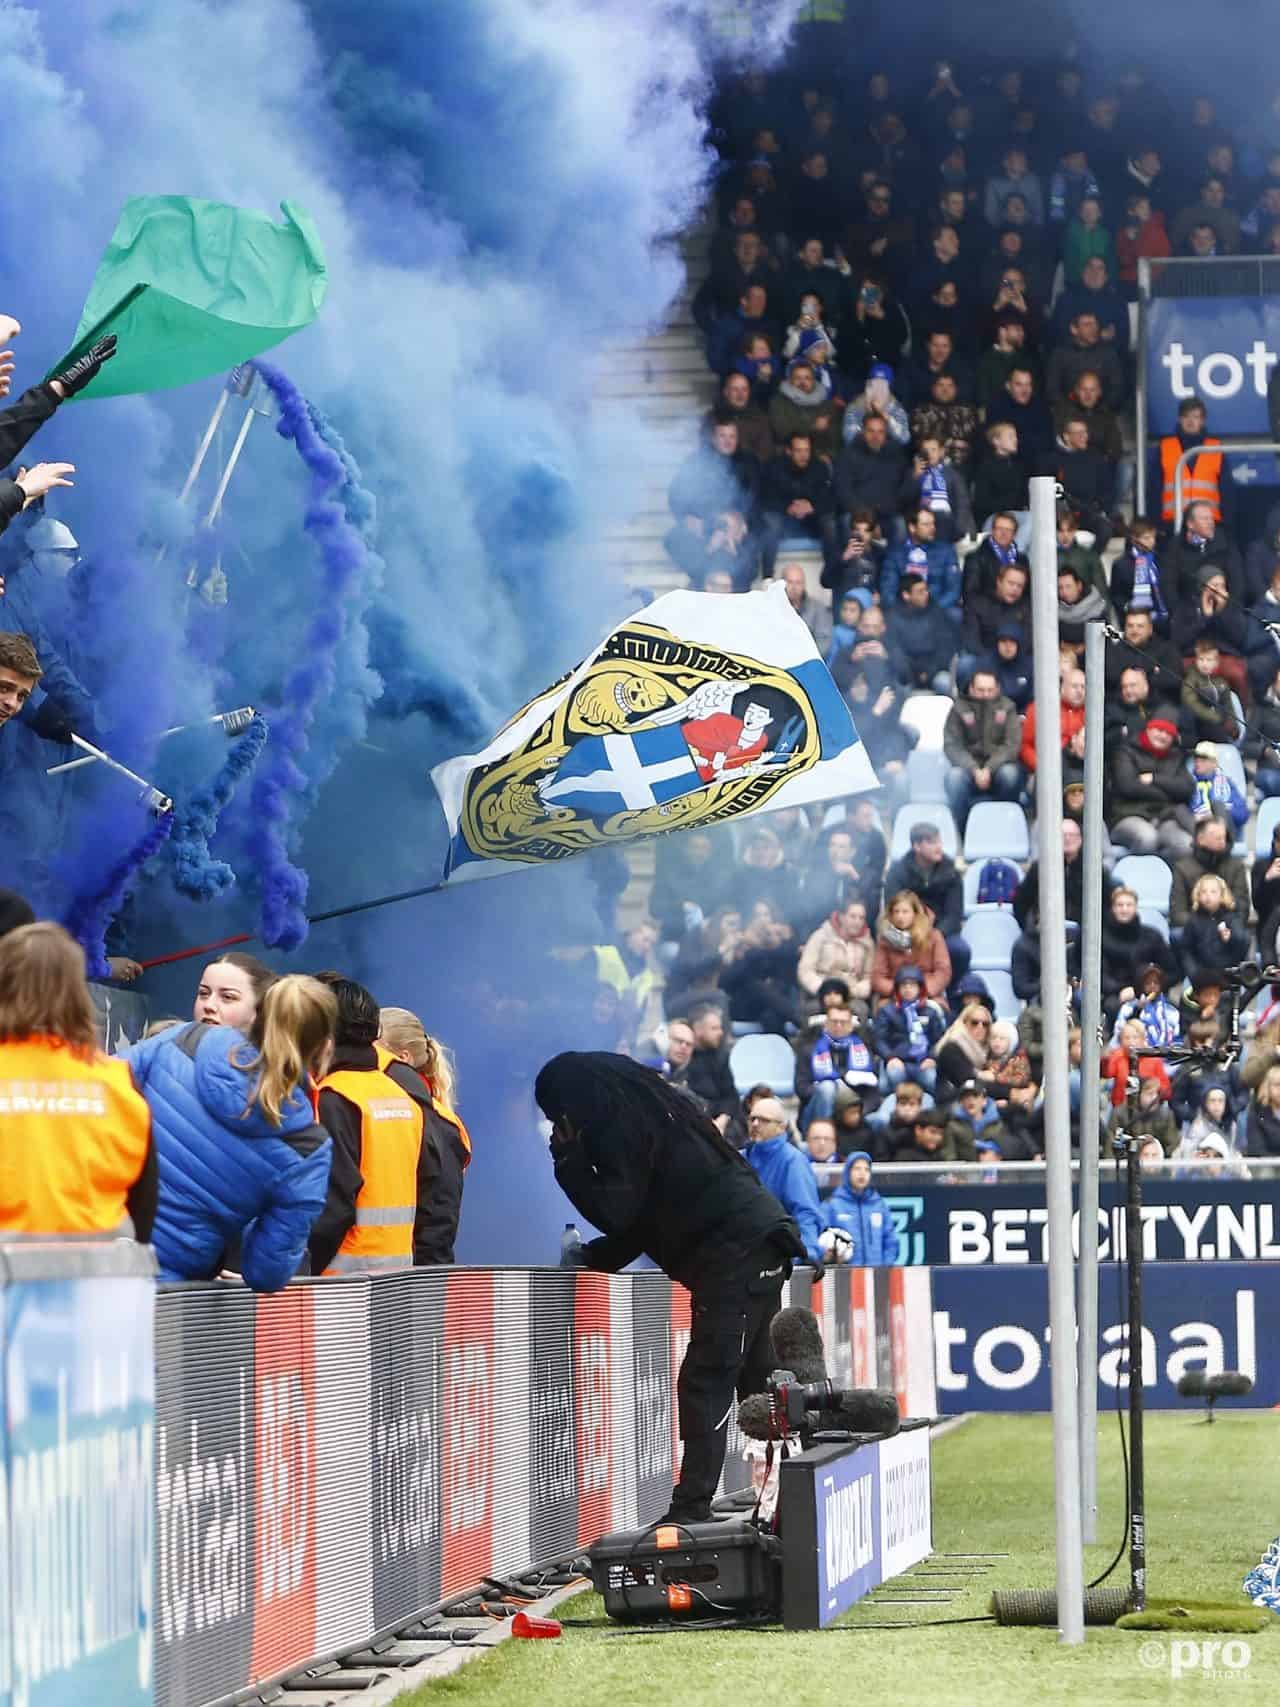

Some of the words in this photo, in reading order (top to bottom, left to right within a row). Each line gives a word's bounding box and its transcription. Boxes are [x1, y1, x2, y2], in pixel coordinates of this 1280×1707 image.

[532, 1324, 575, 1506] totaal
[581, 1332, 609, 1494] BED
[636, 1320, 672, 1480] totaal
[933, 1290, 1256, 1390] toaal
[158, 1366, 247, 1643] totaal
[262, 1373, 308, 1603] BED
[377, 1335, 439, 1564] totaal
[451, 1342, 488, 1534] BED
